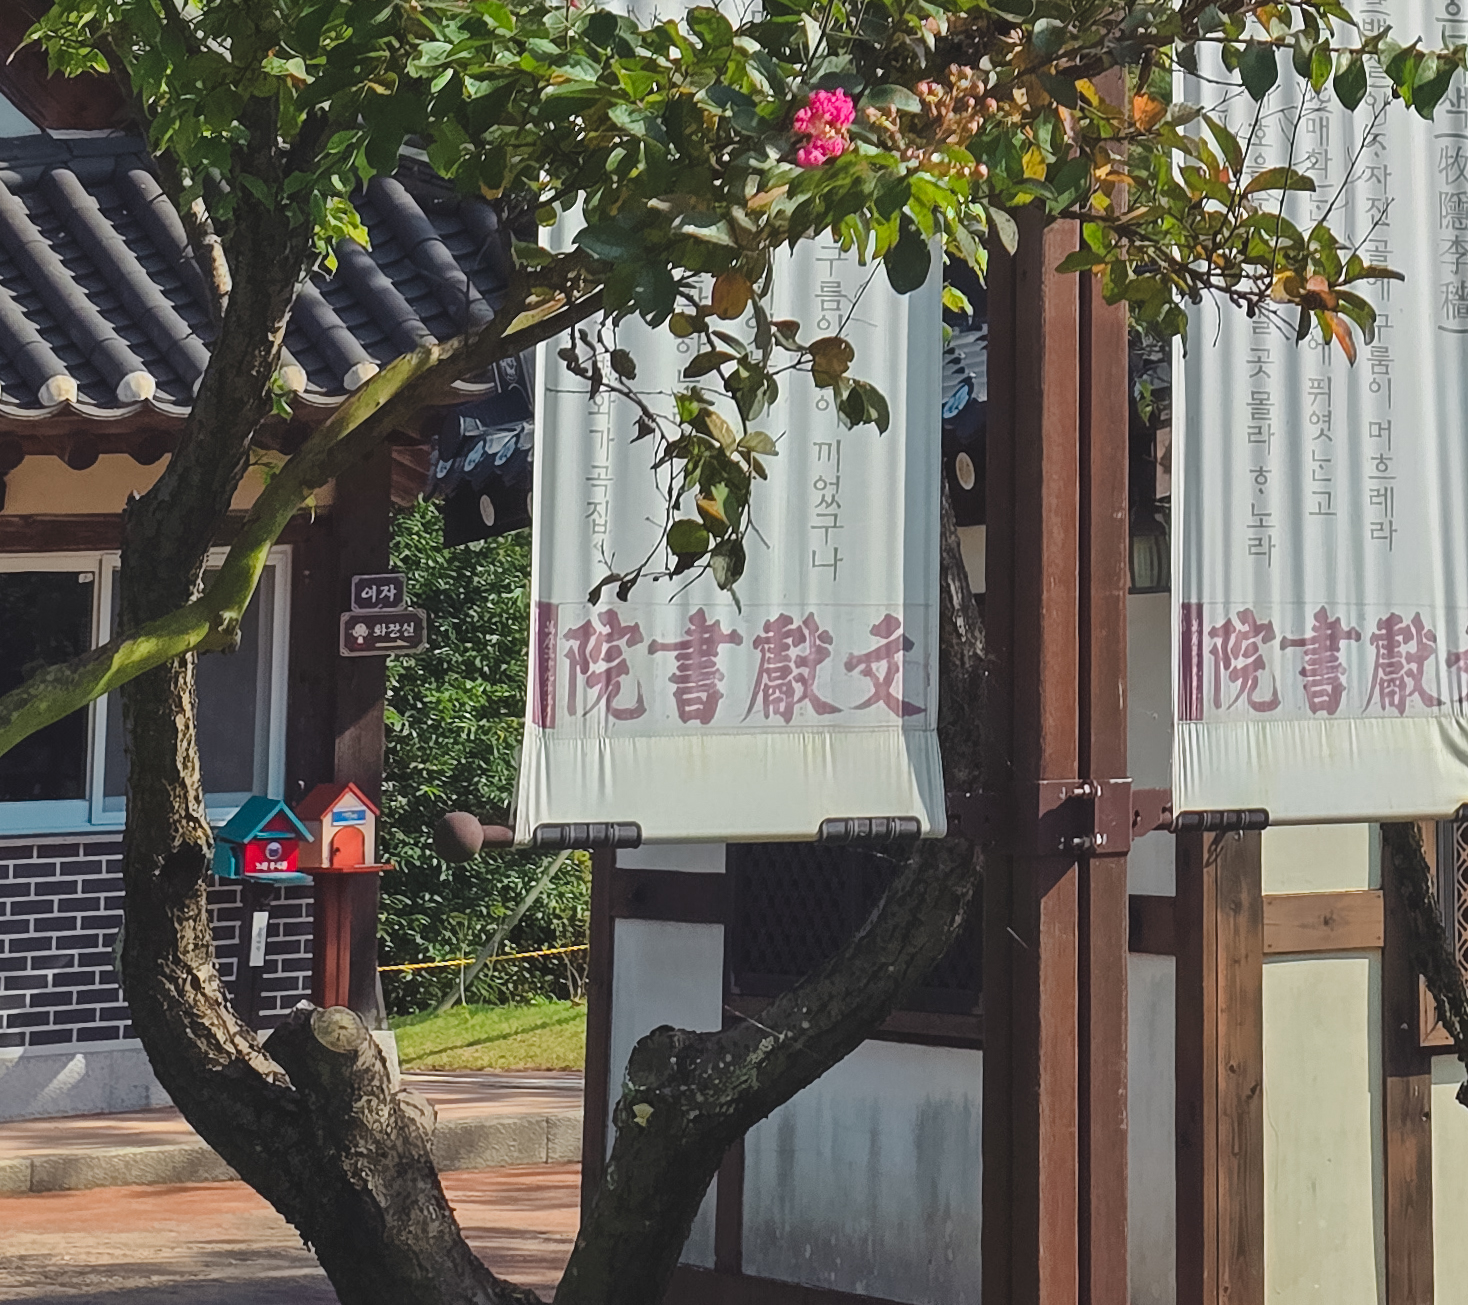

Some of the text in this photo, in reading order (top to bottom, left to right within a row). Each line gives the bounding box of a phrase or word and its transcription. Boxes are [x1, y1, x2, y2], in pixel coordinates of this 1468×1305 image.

[1245, 347, 1275, 379] 곳
[1245, 390, 1276, 456] 몰라
[810, 438, 845, 582] 끼었구나
[1367, 419, 1398, 552] 머흐레라
[361, 584, 397, 603] 여자
[373, 621, 415, 638] 화장실
